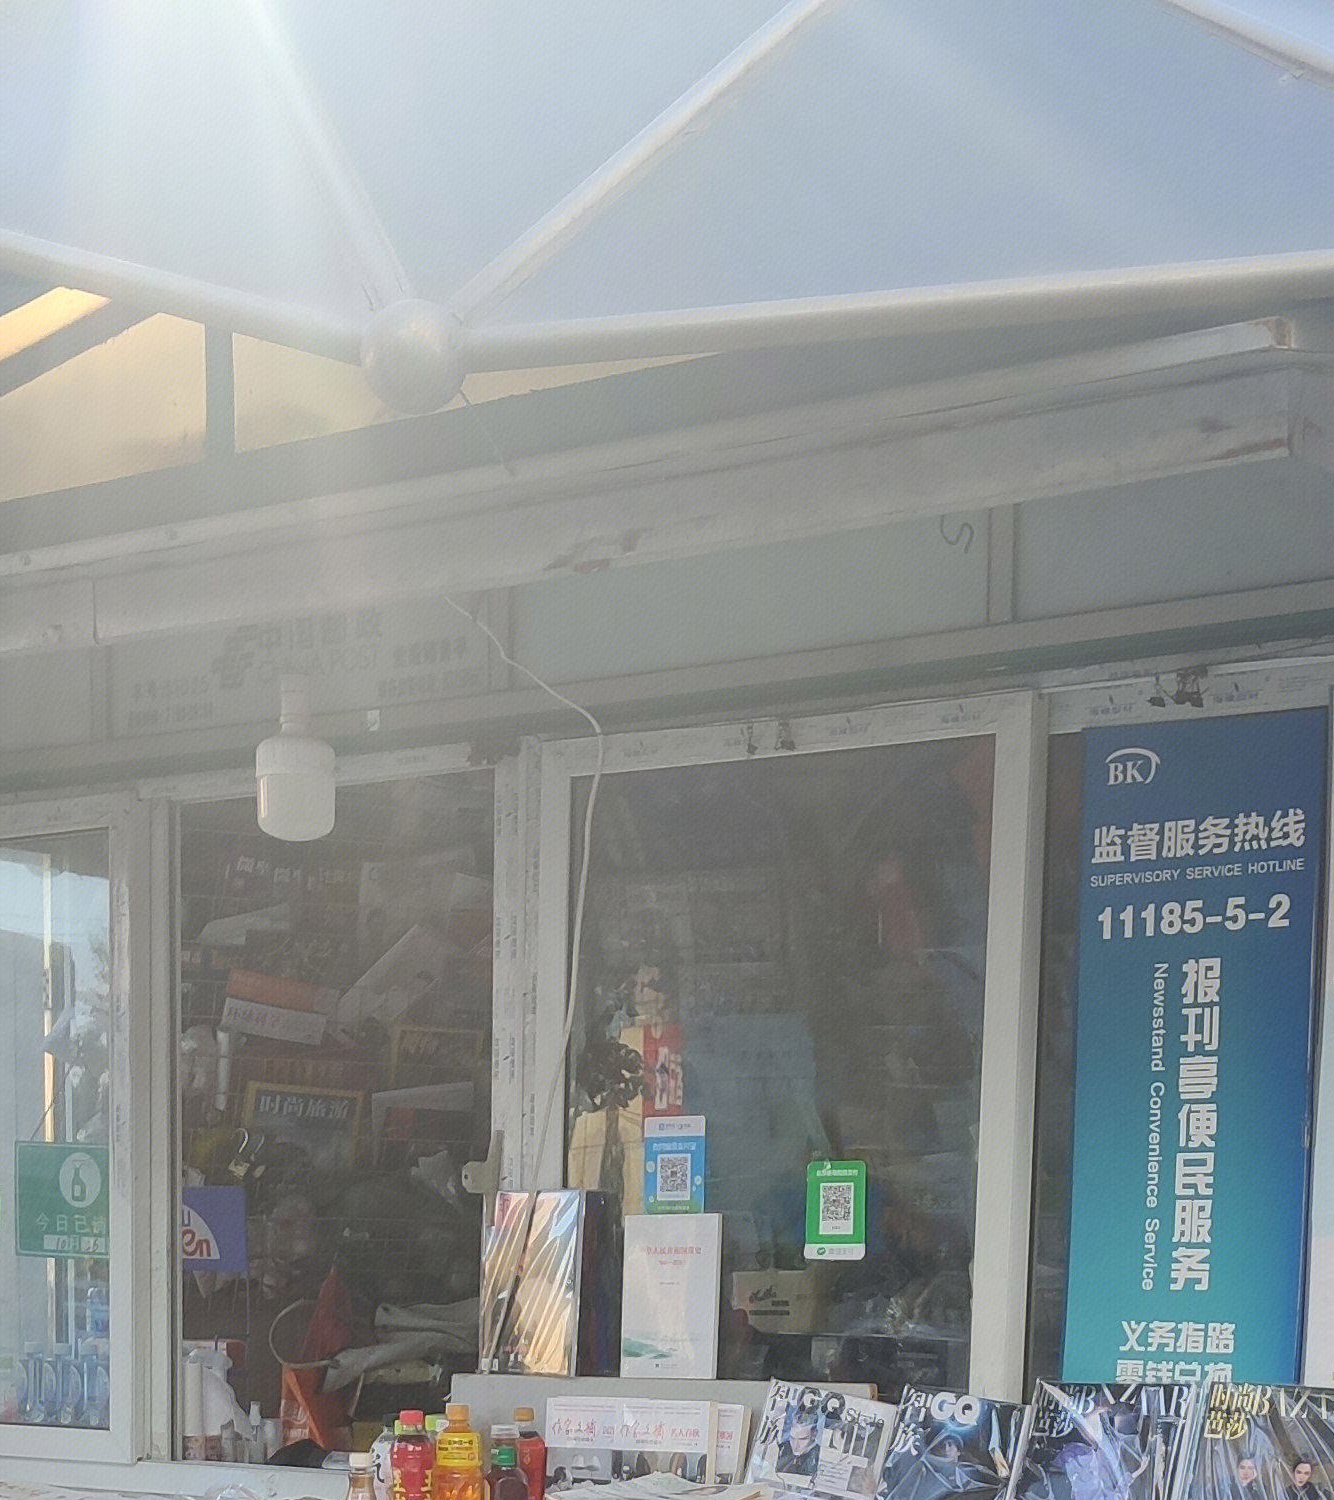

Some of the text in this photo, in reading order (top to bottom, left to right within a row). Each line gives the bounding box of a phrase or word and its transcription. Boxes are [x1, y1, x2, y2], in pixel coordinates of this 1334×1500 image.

[1107, 760, 1145, 786] BK
[1090, 808, 1306, 865] 监督服务热线
[1090, 857, 1306, 888] SUPERVISORY SERVICE HOTLINE
[1097, 893, 1292, 940] 11185-5-2
[1141, 962, 1169, 1292] Newsstand Convenience Service
[1169, 956, 1223, 1292] 报刊亭便民服务
[1118, 1320, 1237, 1354] 义务指路
[930, 1391, 982, 1426] GQ
